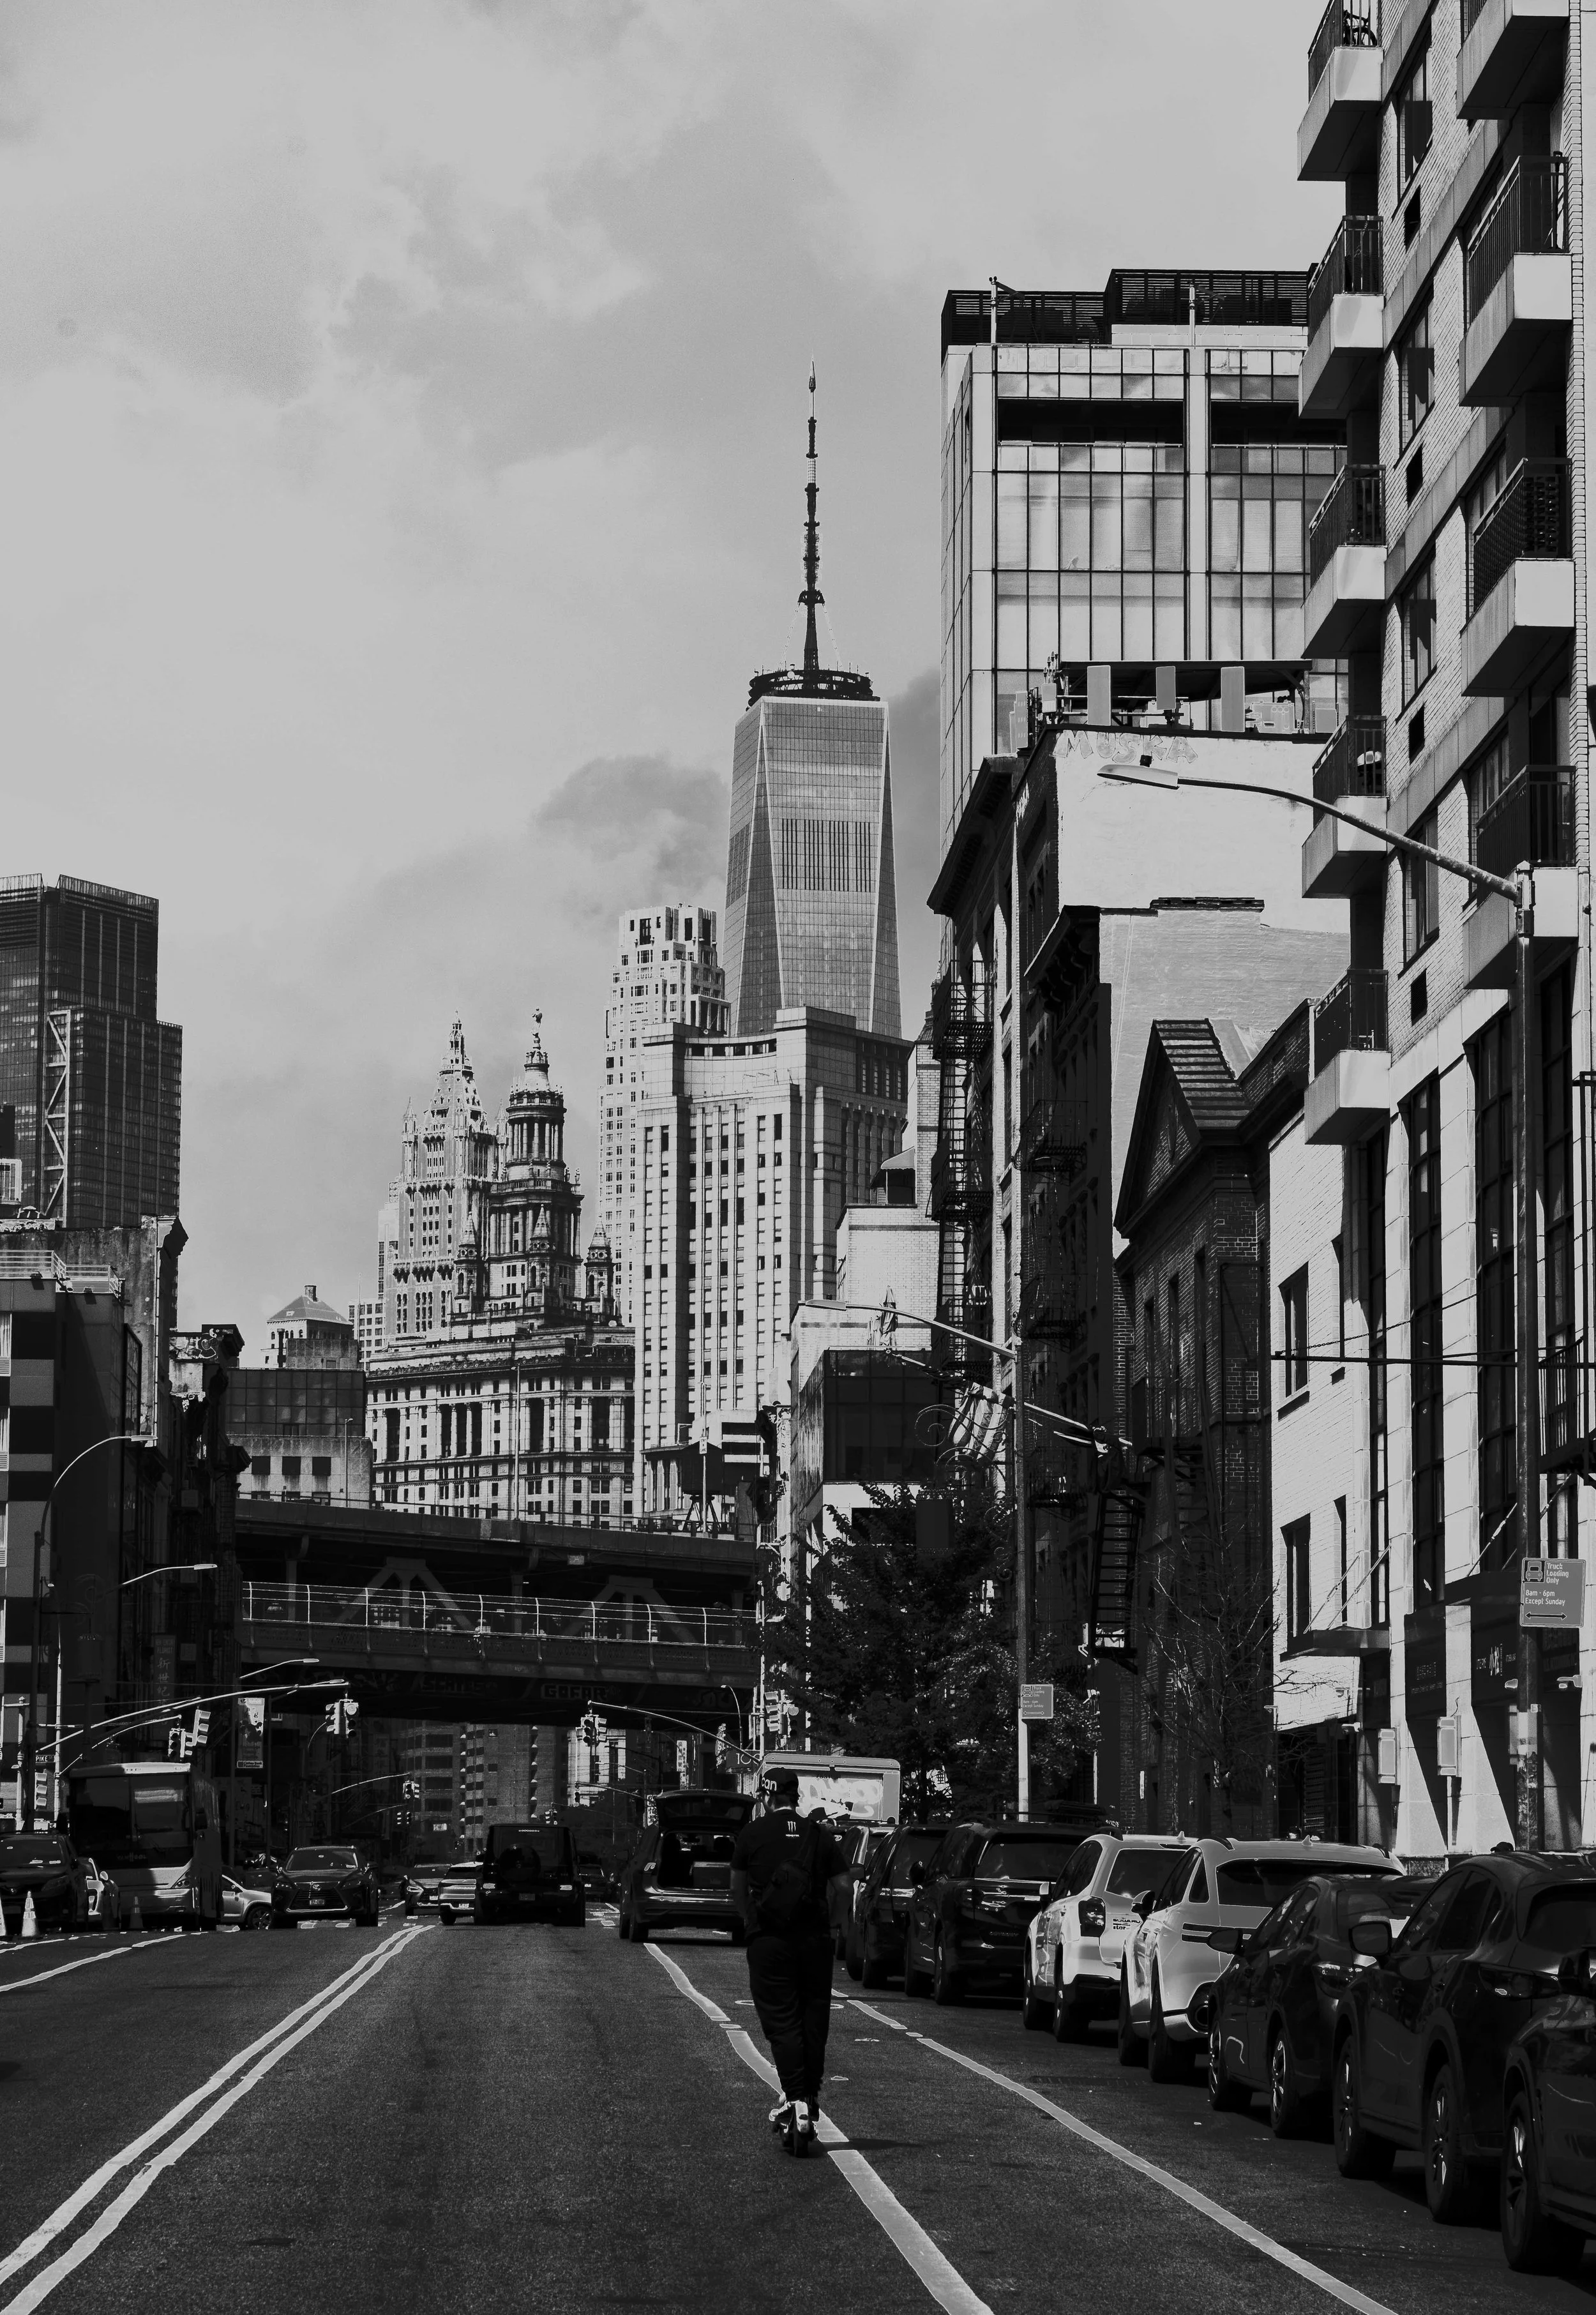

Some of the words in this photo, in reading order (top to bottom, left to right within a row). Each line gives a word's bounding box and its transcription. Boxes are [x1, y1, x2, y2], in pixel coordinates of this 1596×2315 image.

[1053, 729, 1198, 764] MUSKA
[1546, 1570, 1569, 1578] Loading
[1546, 1577, 1560, 1585] Only
[1525, 1597, 1544, 1606] Except
[1545, 1598, 1565, 1606] Sunday
